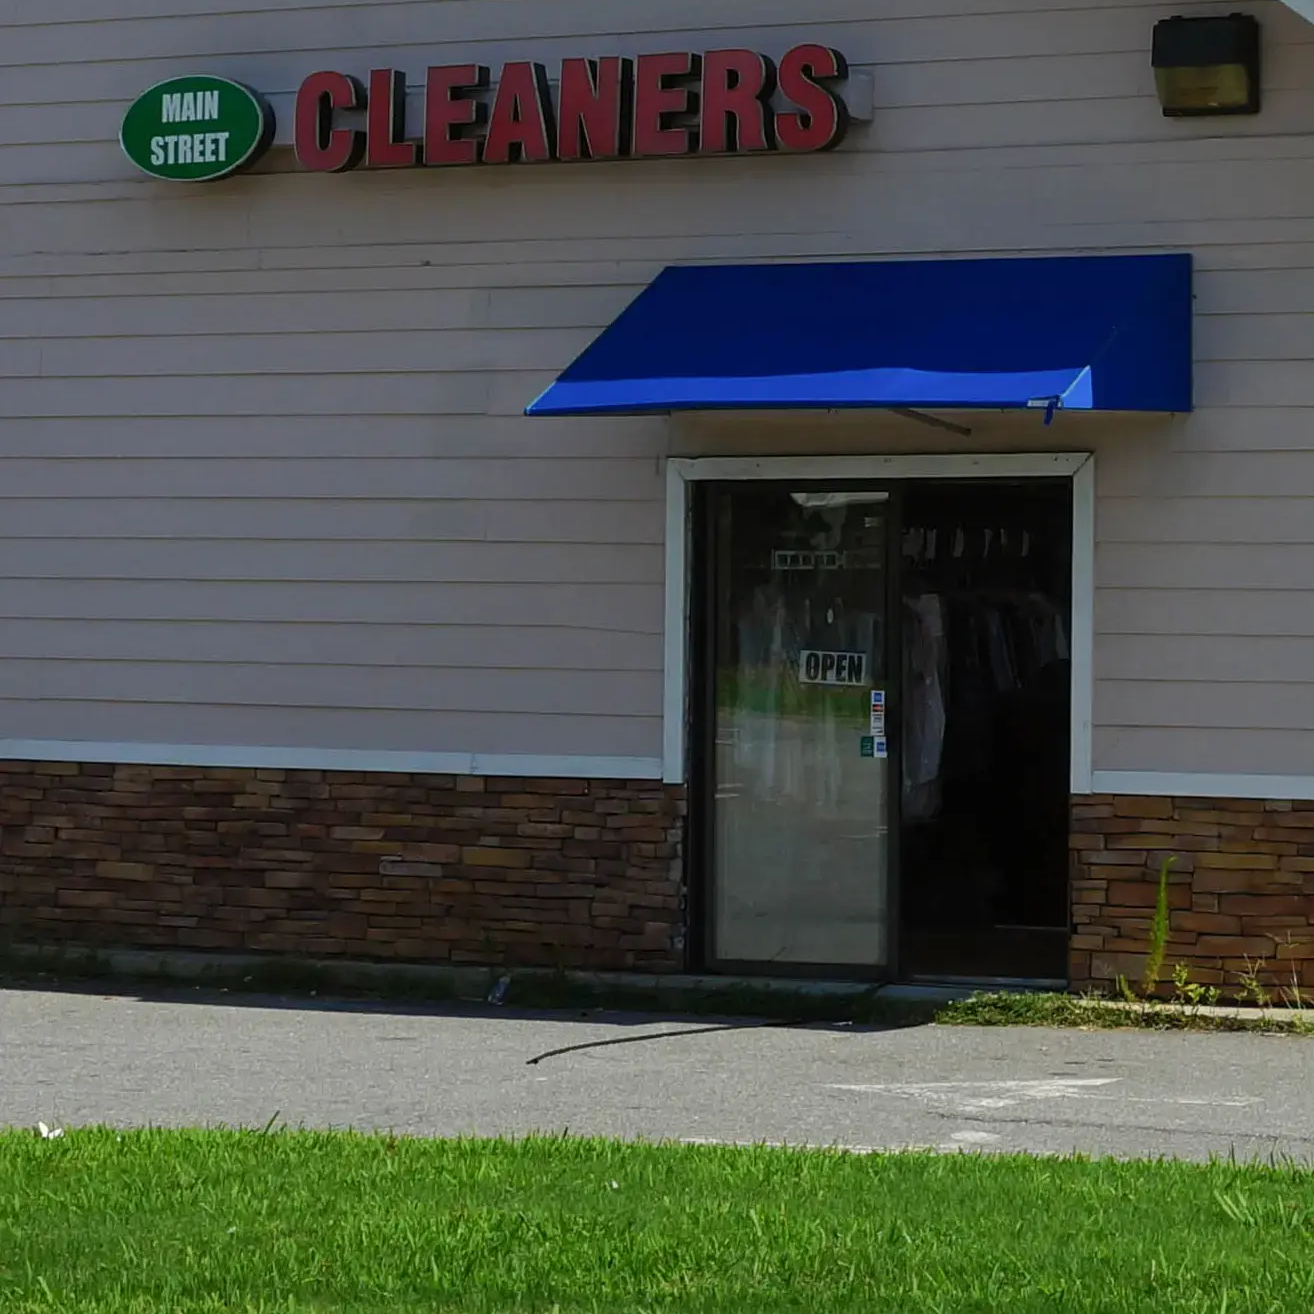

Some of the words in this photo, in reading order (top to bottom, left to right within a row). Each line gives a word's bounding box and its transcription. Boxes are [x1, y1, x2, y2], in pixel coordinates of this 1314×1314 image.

[161, 90, 219, 123] MAIN
[294, 43, 843, 173] CLEANERS
[150, 131, 230, 166] STREET
[805, 652, 863, 684] OPEN
